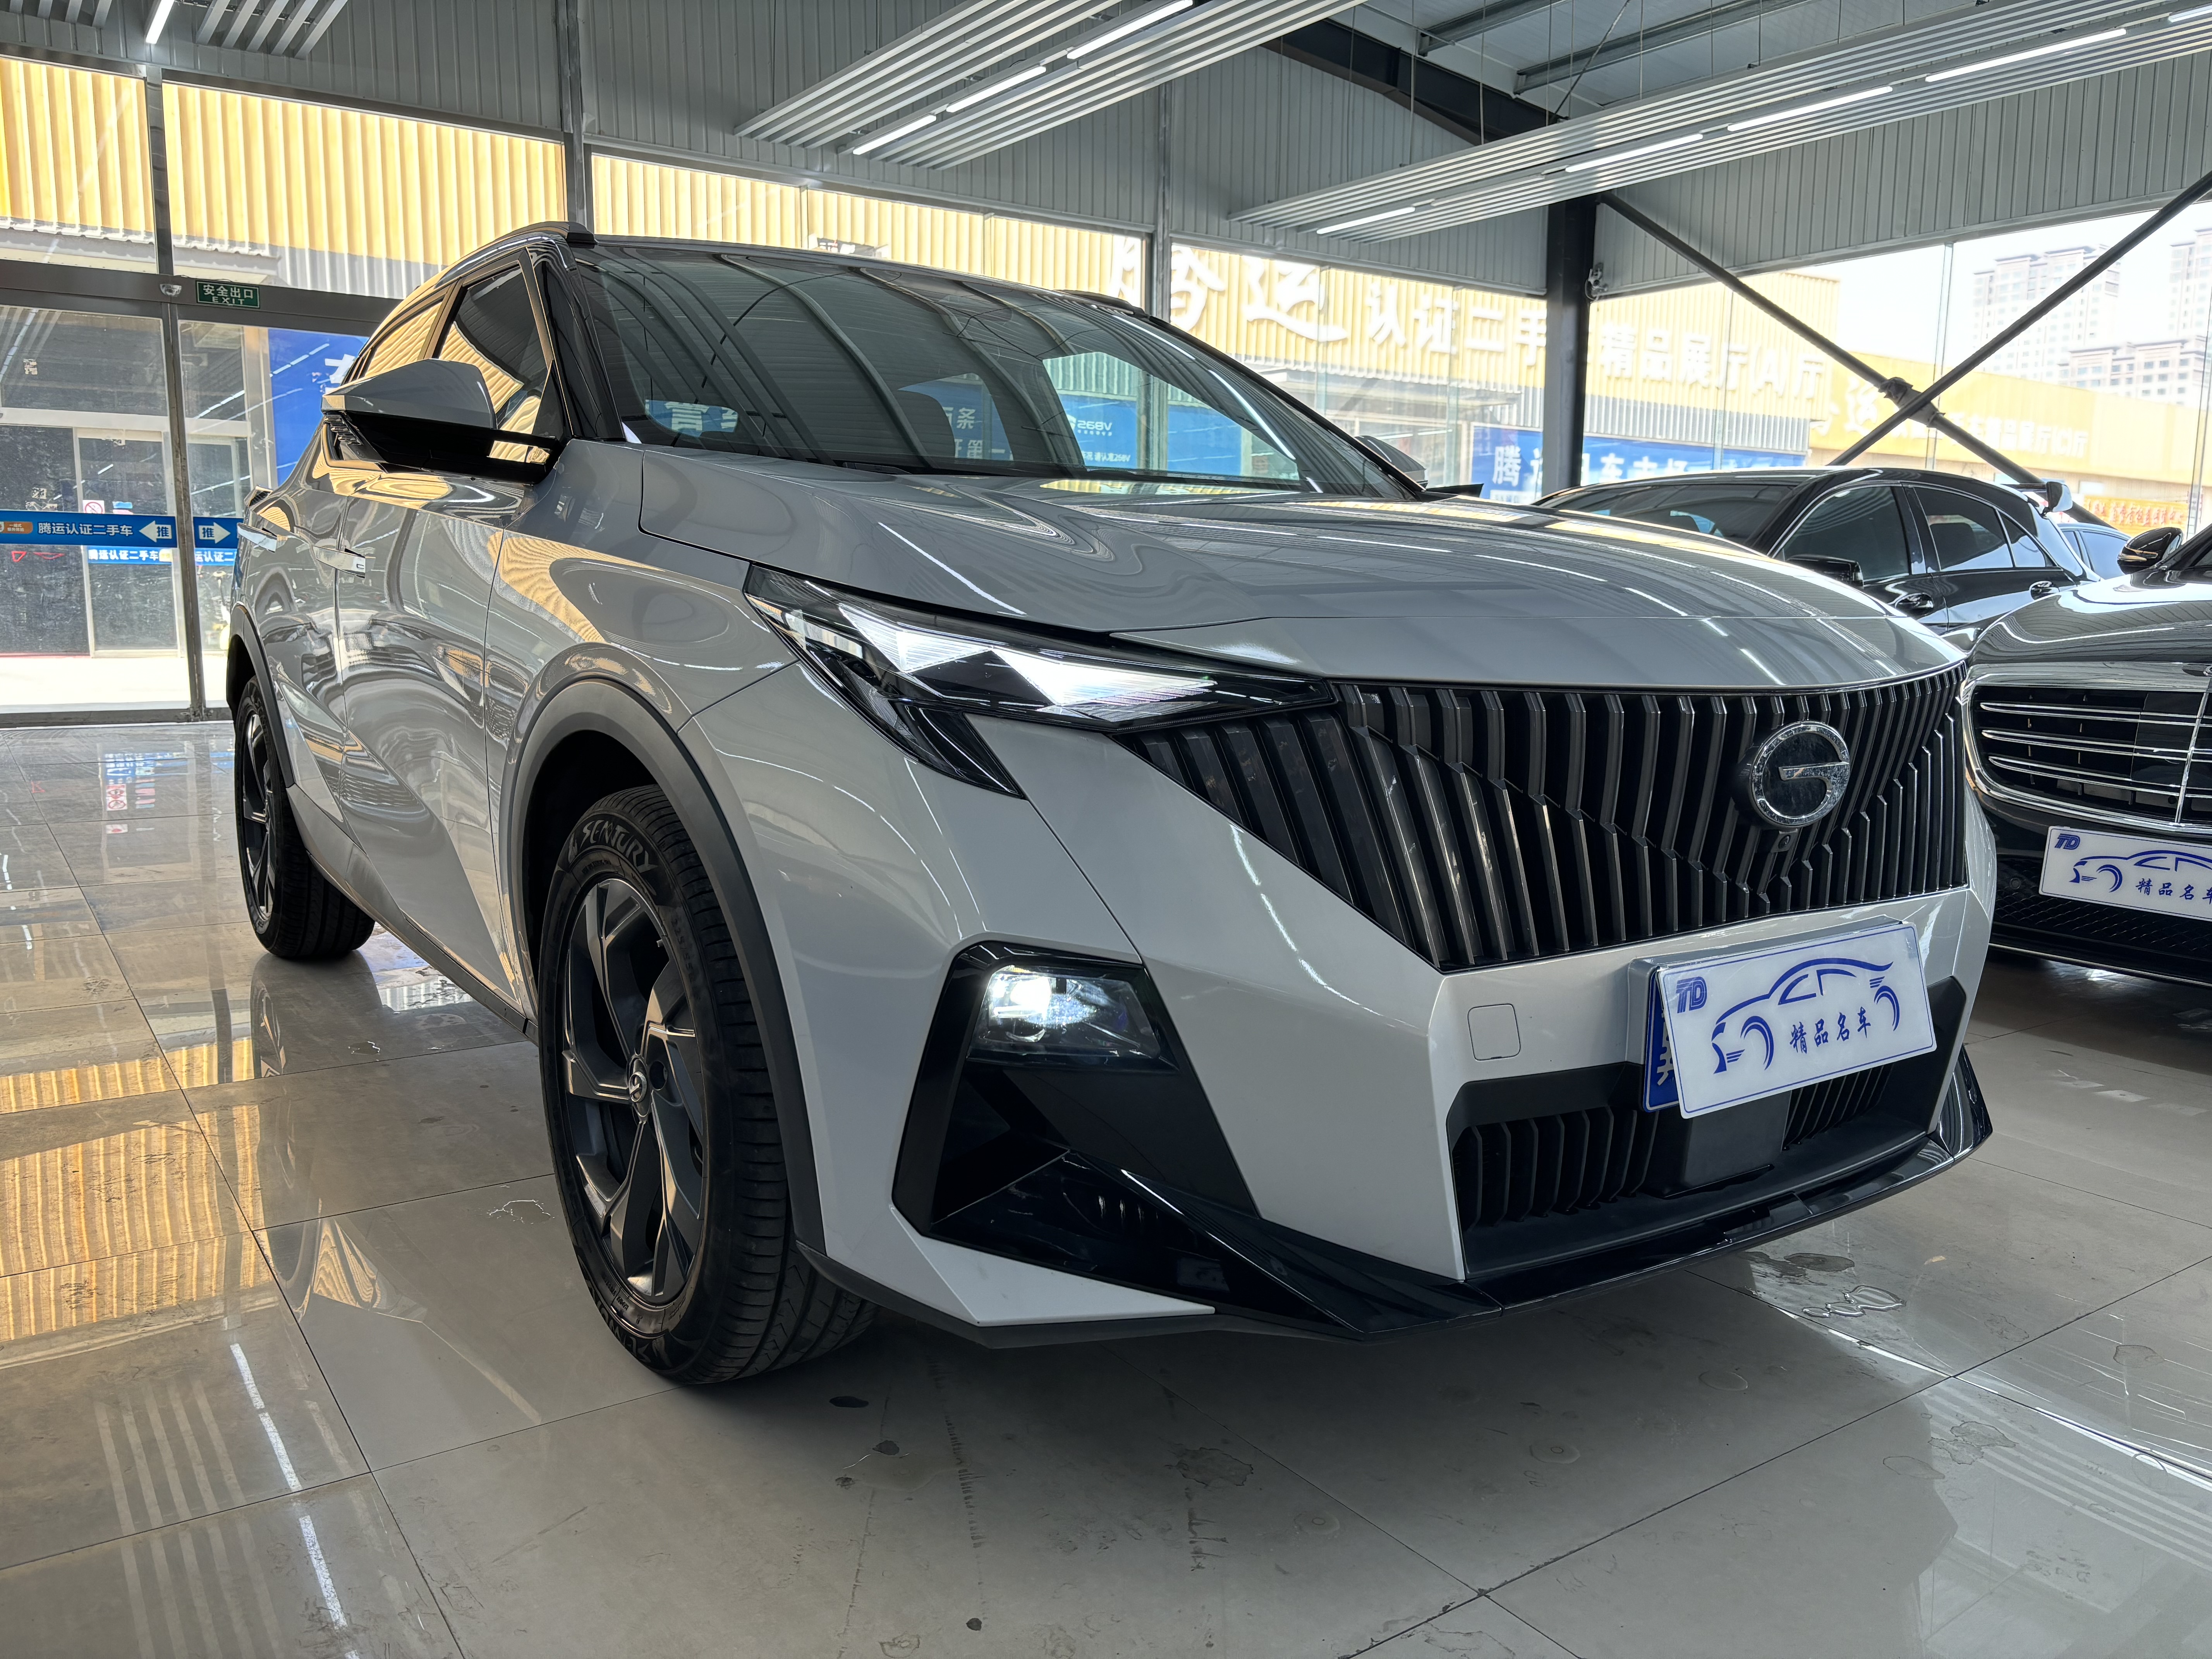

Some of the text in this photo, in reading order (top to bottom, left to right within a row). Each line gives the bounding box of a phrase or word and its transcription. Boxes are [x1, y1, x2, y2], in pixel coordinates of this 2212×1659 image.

[203, 284, 254, 299] 安全出口
[212, 296, 245, 305] EXIT
[1077, 420, 1113, 431] 268V
[38, 522, 134, 537] 腾运认证二手车
[157, 526, 170, 537] 推
[202, 527, 215, 538] 推
[580, 820, 658, 873] SENTURY
[1789, 1006, 1871, 1054] 精品名车
